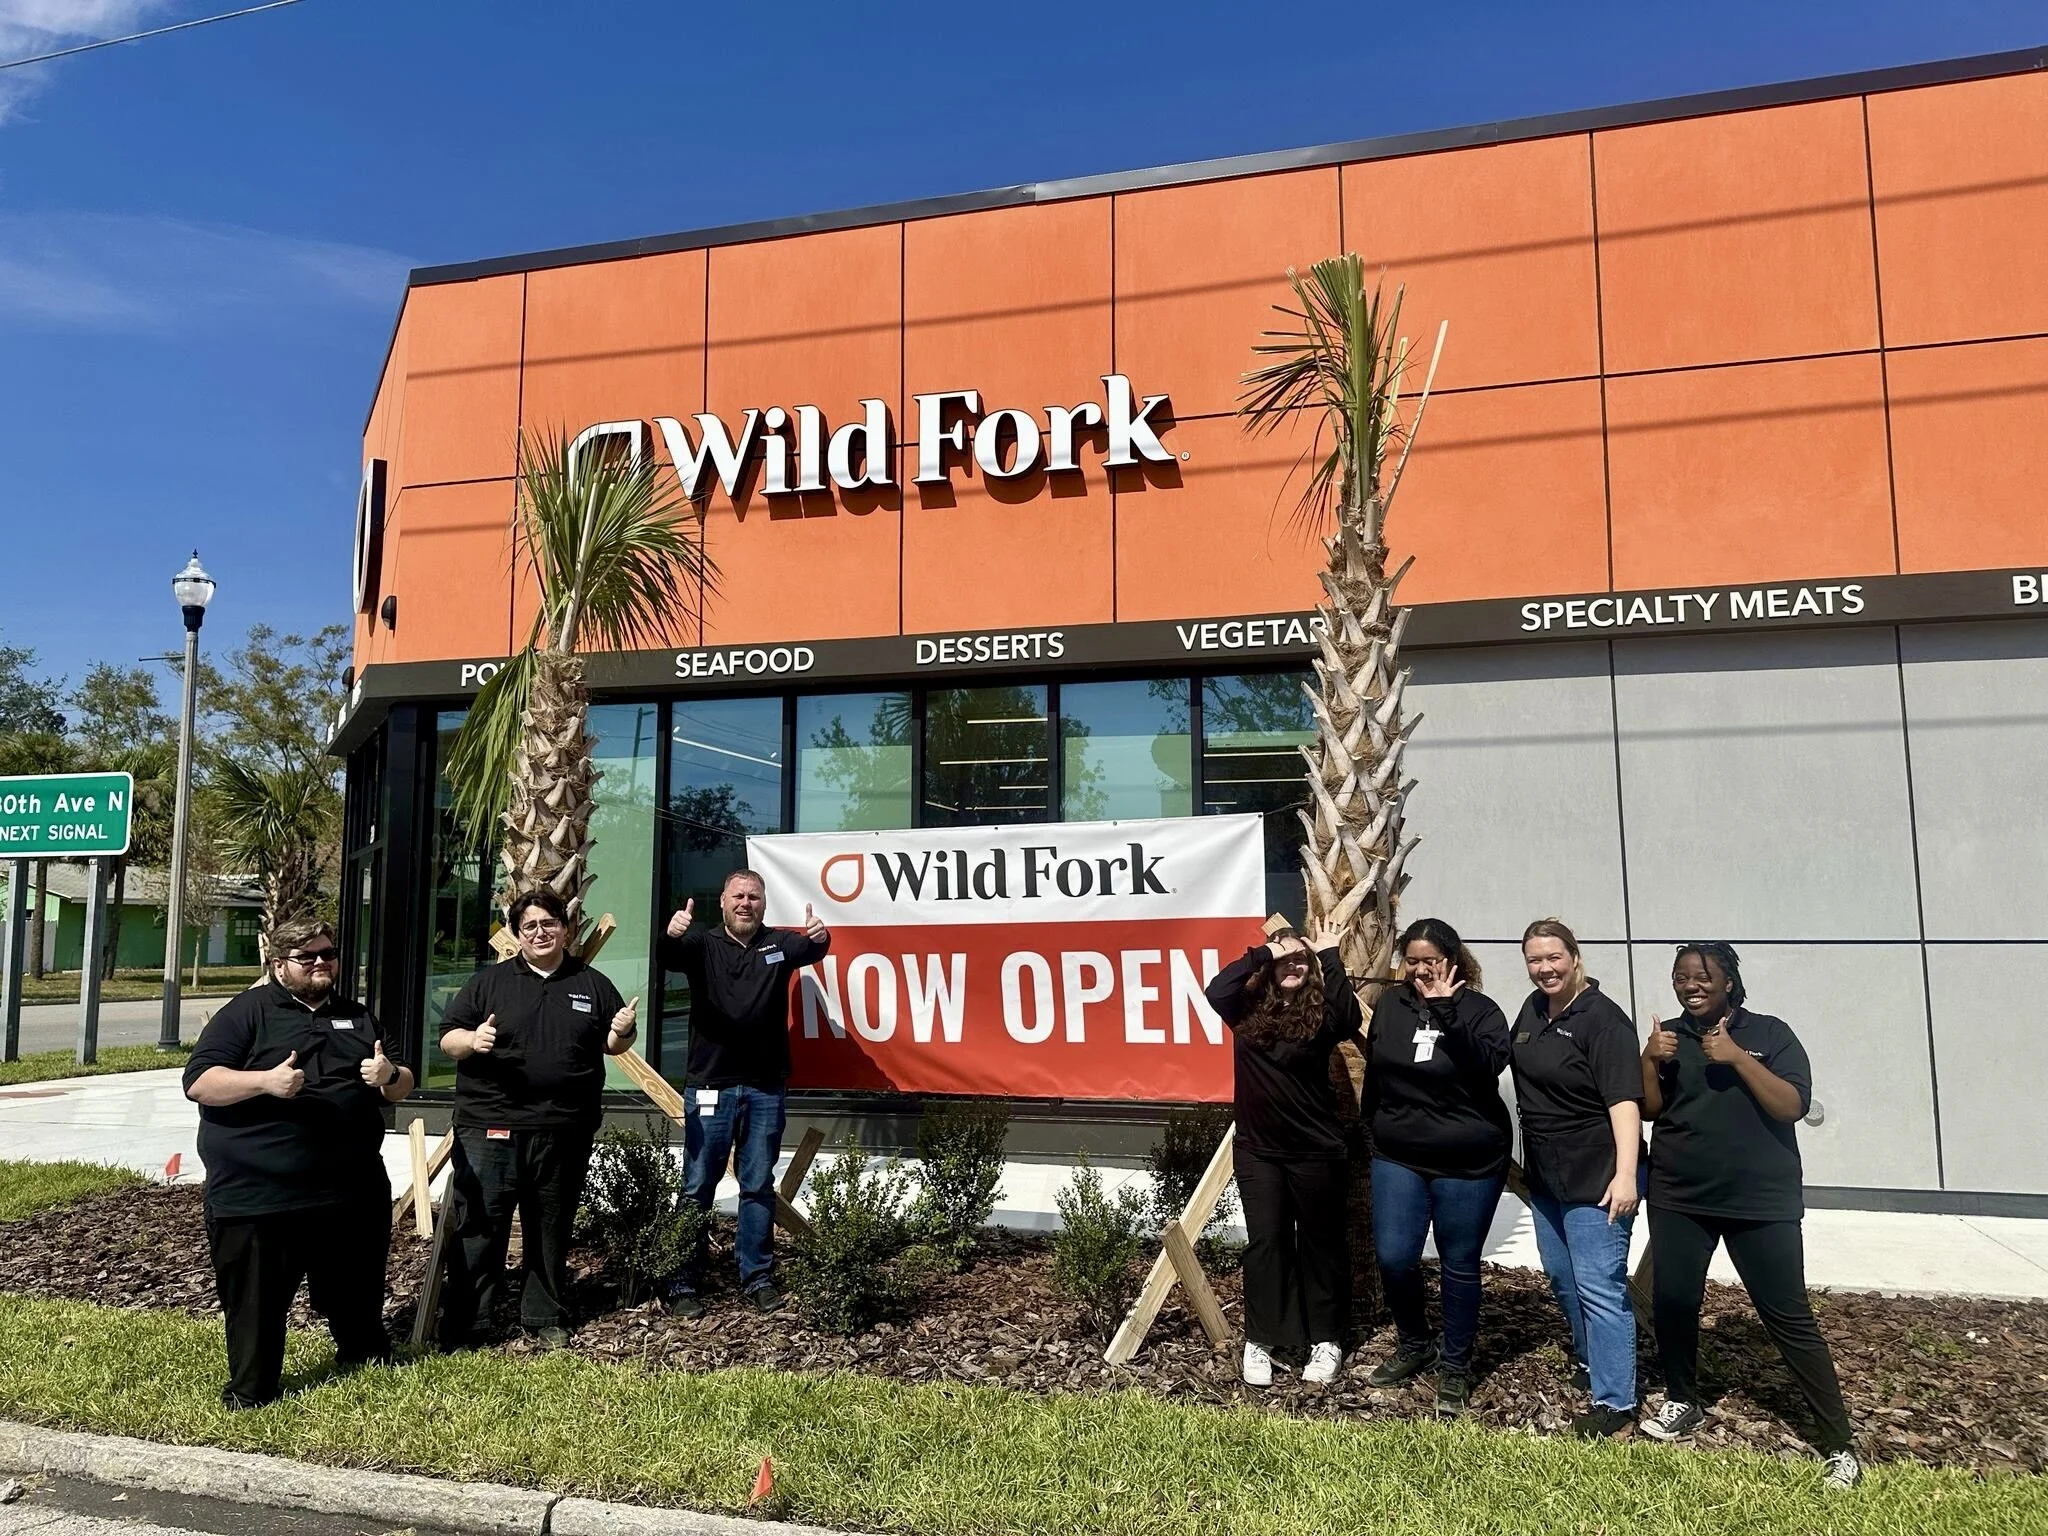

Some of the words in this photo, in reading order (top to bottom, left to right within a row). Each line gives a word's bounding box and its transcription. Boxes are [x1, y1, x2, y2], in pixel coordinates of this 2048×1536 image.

[653, 399, 893, 499] Wild
[912, 374, 1176, 483] Fork
[1520, 593, 1719, 632] SPECIALTY
[1729, 585, 1865, 620] MEATS
[674, 647, 815, 678] SEAFOOD
[914, 632, 1065, 664] DESSERTS
[0, 794, 41, 815] 0th
[53, 793, 96, 813] Ave
[108, 790, 123, 812] N
[0, 825, 41, 841] NEXT
[47, 823, 108, 840] SIGNAL
[871, 848, 1010, 901] Wild
[1020, 843, 1169, 898] Fork
[799, 952, 967, 1043] NOW
[1001, 949, 1224, 1045] OPEN
